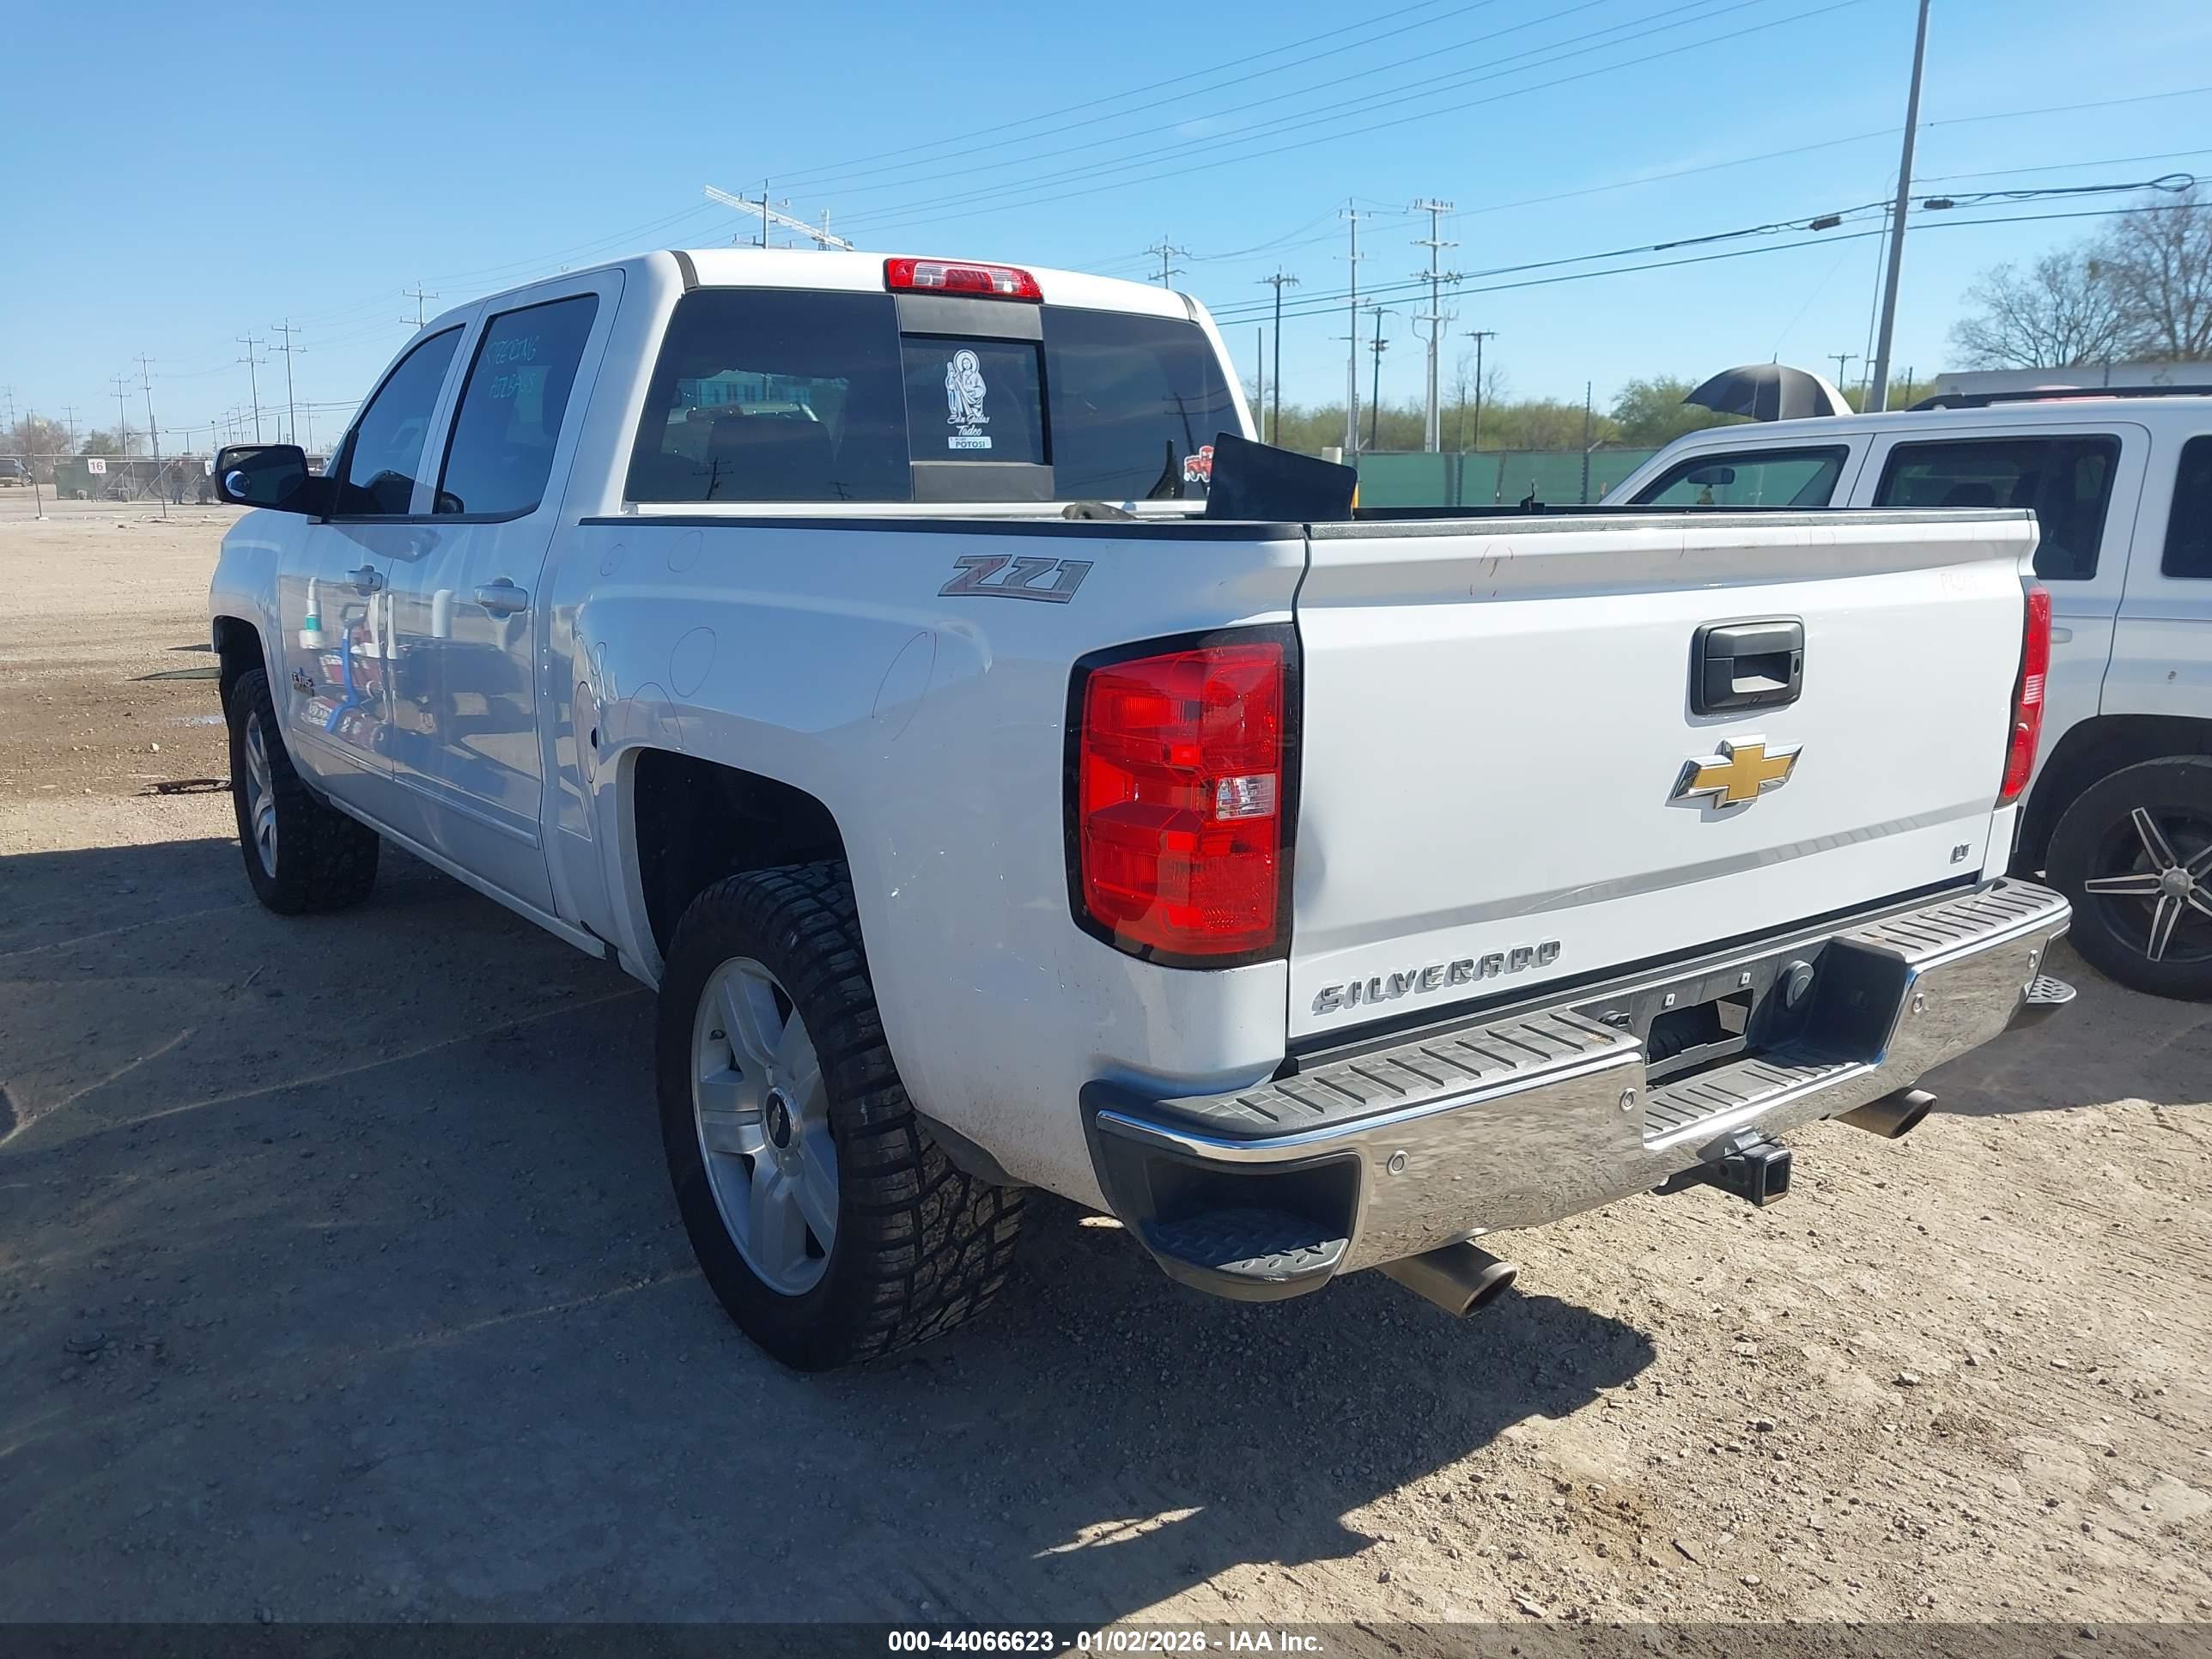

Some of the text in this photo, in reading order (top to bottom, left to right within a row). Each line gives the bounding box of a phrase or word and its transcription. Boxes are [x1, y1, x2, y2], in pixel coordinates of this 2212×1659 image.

[90, 461, 104, 471] 16
[938, 554, 1094, 605] Z71
[1311, 940, 1561, 1016] SILVERADO
